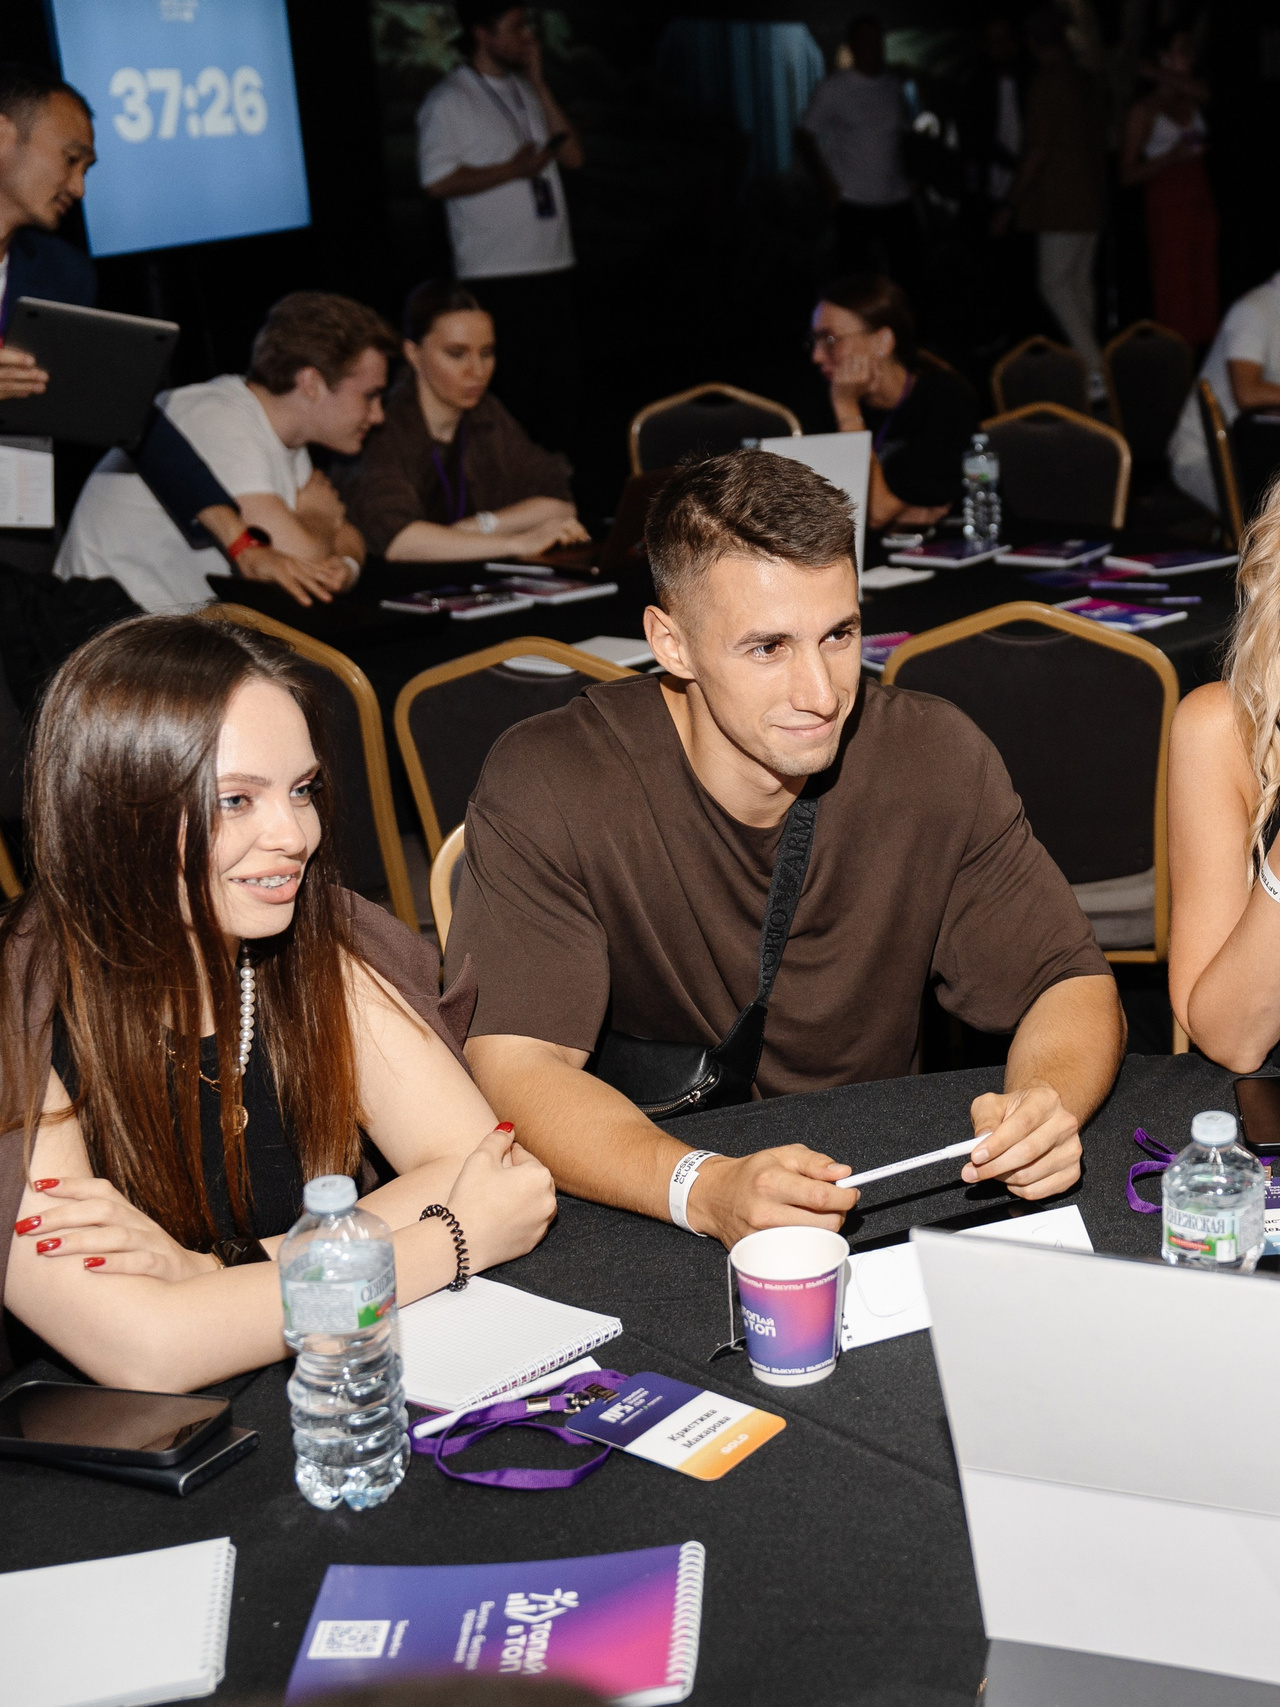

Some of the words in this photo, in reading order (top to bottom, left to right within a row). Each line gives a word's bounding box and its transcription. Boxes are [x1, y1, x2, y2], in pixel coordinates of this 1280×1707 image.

[109, 65, 268, 143] 37:26
[679, 1161, 696, 1185] CLUB
[1166, 1206, 1226, 1234] ЕНЕЖСКАЯ
[764, 1282, 803, 1291] ВЫКУПЫ
[748, 1319, 777, 1338] ТОП
[771, 1366, 805, 1375] ВЫКУПЫ
[667, 1407, 718, 1442] Кристина
[681, 1415, 732, 1449] Макарова
[720, 1433, 749, 1456] GOLD
[498, 1634, 527, 1673] ТОП
[520, 1619, 552, 1675] ТОПАЙ
